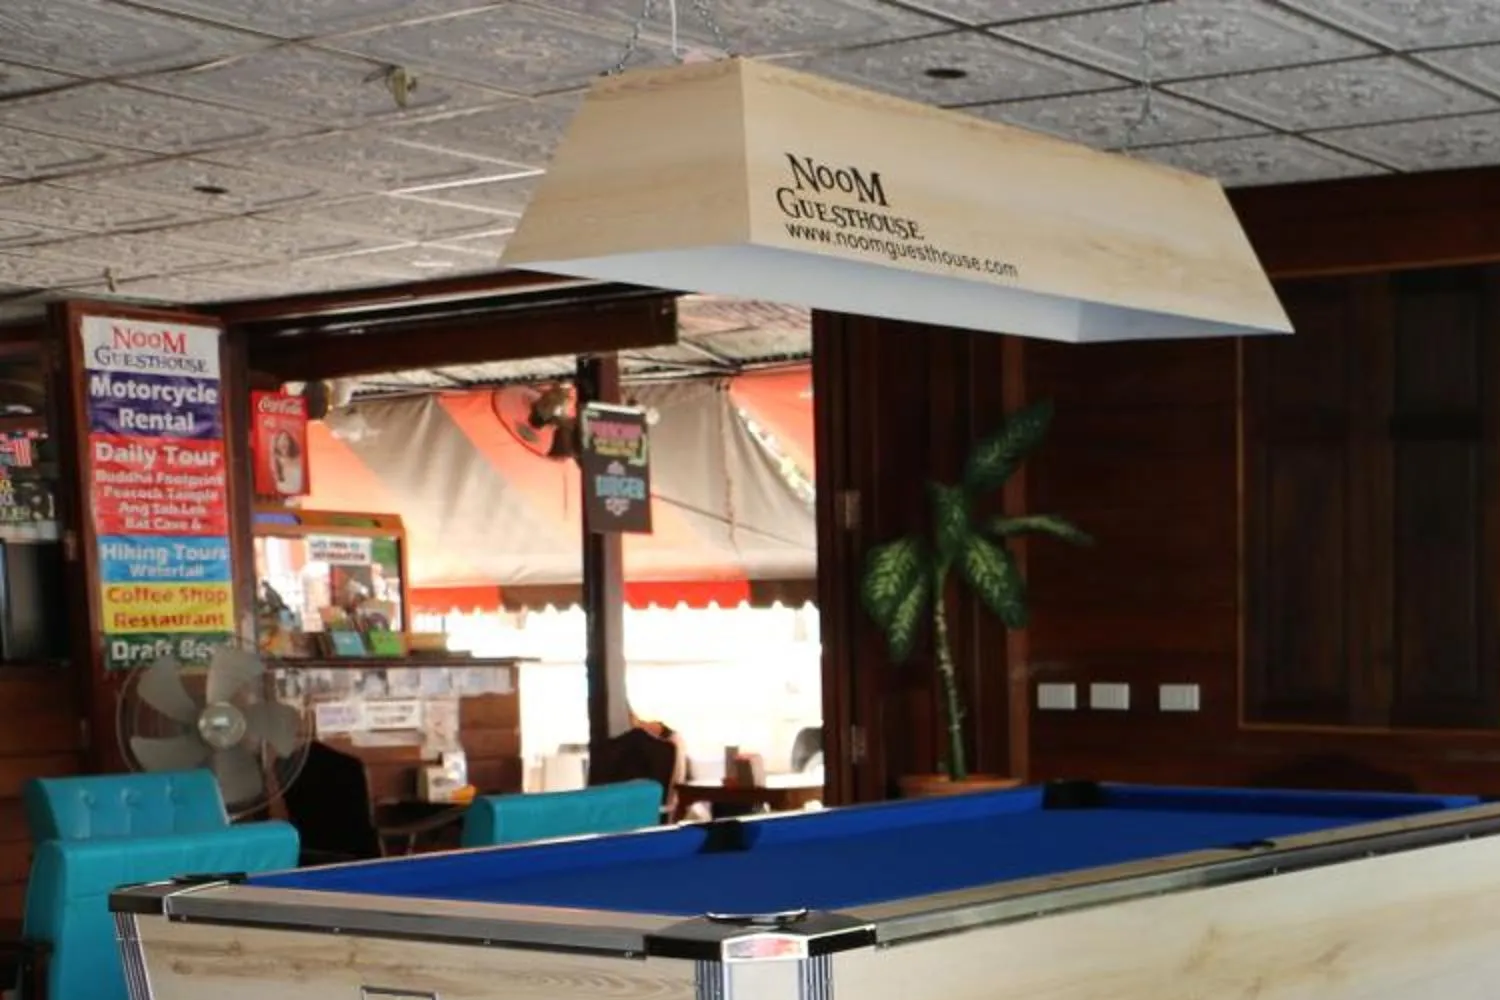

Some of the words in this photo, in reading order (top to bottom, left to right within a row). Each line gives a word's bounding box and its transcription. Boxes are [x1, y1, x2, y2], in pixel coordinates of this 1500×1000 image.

[784, 152, 890, 207] NooM
[784, 223, 1019, 278] www.noomguesthouse.com
[91, 375, 218, 407] Motorcycle
[119, 409, 195, 432] Rental
[96, 443, 157, 469] Daily
[164, 446, 220, 466] Tour
[102, 543, 169, 564] Hiking
[107, 587, 174, 604] Coffee
[179, 588, 228, 603] Shop
[113, 612, 226, 629] Restaurant
